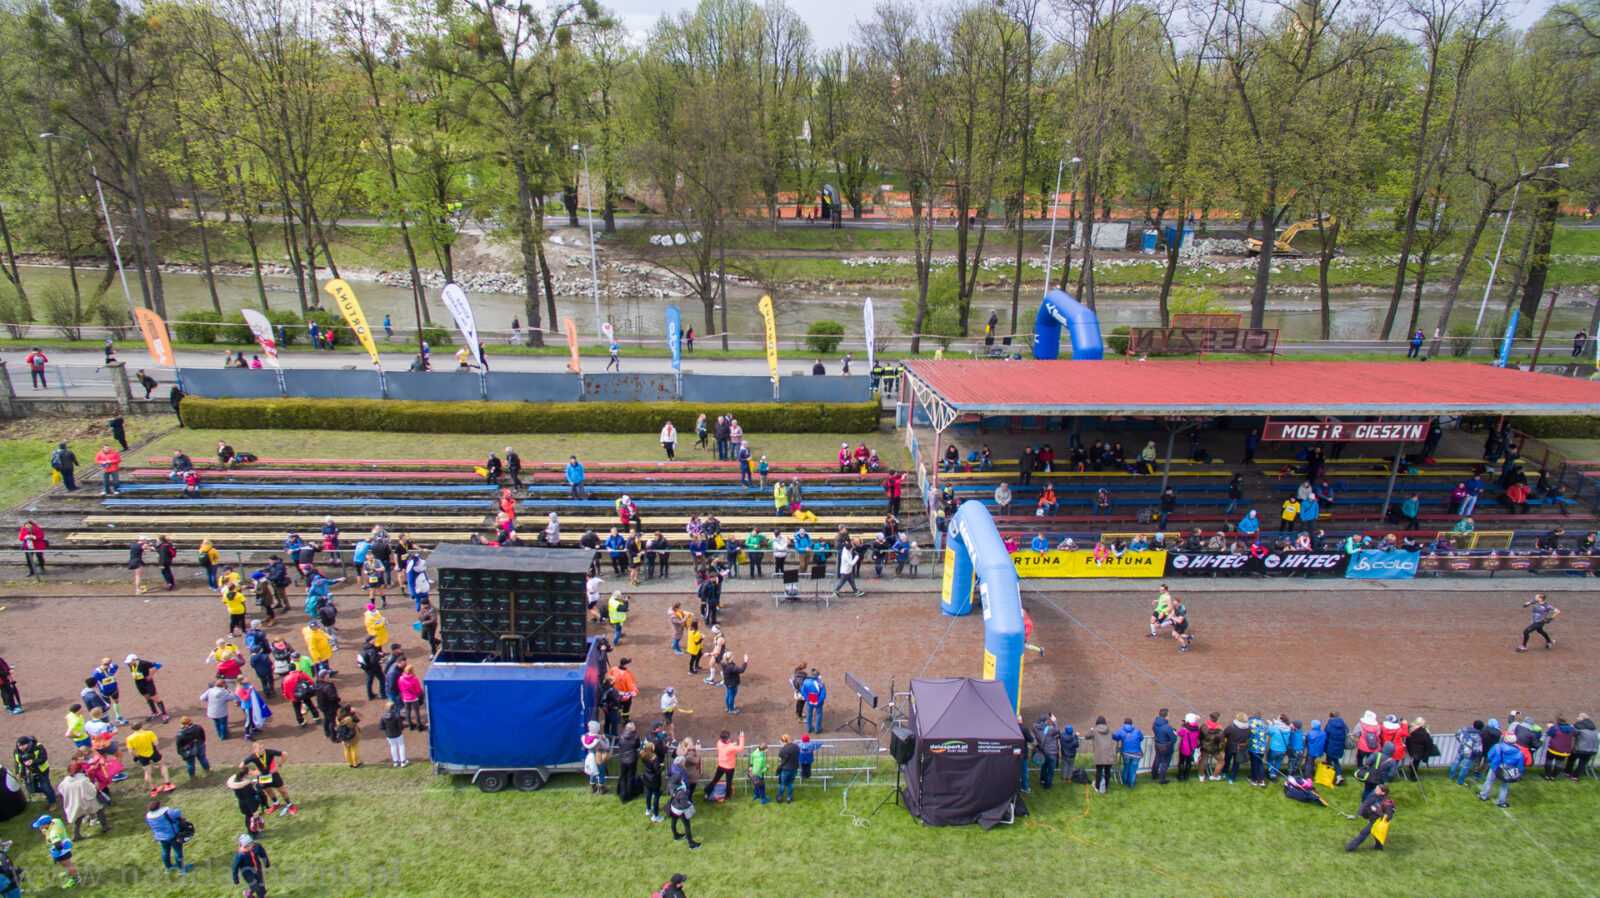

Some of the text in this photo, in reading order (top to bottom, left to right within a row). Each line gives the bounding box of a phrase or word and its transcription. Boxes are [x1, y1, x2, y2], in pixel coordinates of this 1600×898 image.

[1355, 424, 1424, 439] CIESZYN
[1014, 557, 1060, 565] RTUNA
[1188, 555, 1248, 568] HI-TEC
[1280, 555, 1340, 568] HI-TEC
